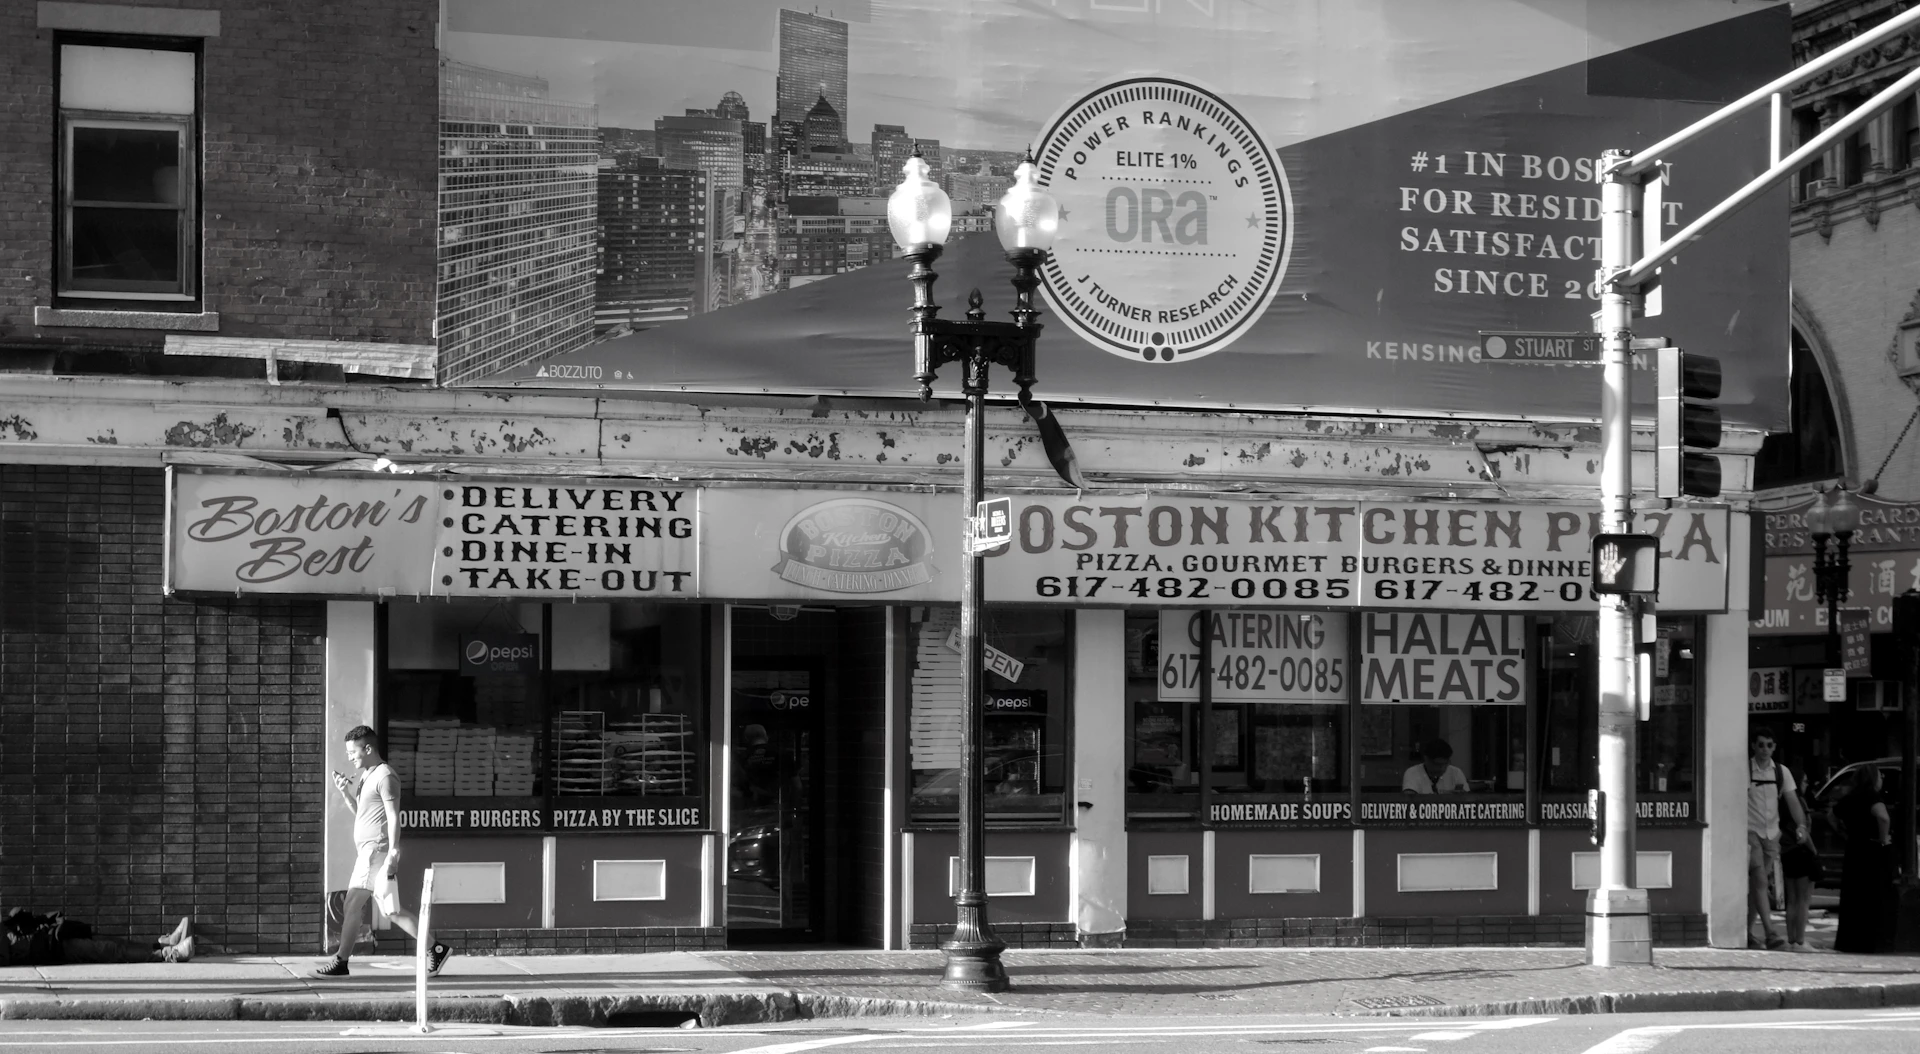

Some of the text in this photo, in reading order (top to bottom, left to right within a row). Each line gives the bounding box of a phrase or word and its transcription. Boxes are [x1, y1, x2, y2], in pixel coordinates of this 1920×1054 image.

[1065, 110, 1249, 187] POWER RANKINGS
[1116, 150, 1197, 170] ELITE 1%
[1411, 151, 1448, 173] #1
[1465, 151, 1506, 176] IN
[1400, 187, 1476, 214] FOR
[1434, 268, 1549, 297] SINCE
[1078, 274, 1239, 324] J TURNER RESEARCH
[1514, 338, 1595, 358] STUART ST
[549, 364, 603, 380] BOZZUTO
[461, 486, 685, 513] DELIVERY
[187, 489, 428, 543] Boston's
[461, 515, 693, 540] CATERING
[797, 505, 914, 542] BOSTON
[1857, 507, 1920, 526] GARD
[821, 531, 890, 547] Kitchen
[985, 503, 1229, 559] OSTON
[1249, 506, 1521, 549] KITCHEN
[1545, 510, 1721, 564] PZA
[235, 535, 374, 585] Best
[461, 541, 632, 565] DINE-IN
[803, 544, 910, 568] PIZZA
[1182, 554, 1328, 575] GOURMET
[1341, 556, 1473, 576] BURGERS
[1484, 558, 1503, 575] &
[1508, 558, 1591, 577] DINNE
[459, 567, 692, 593] TAKE-OUT
[825, 572, 876, 590] CATERING
[881, 561, 926, 588] DINNE
[1036, 575, 1602, 603] 617-482-0085 617-482-0
[1188, 613, 1325, 650] CATERING
[1366, 612, 1521, 656] HALAL
[489, 645, 533, 661] pepsi
[984, 648, 1019, 678] PEN
[1161, 653, 1344, 693] 617-482-0085
[1364, 658, 1521, 701] MEATS
[996, 697, 1031, 708] pepsi
[470, 809, 541, 828] BURGERS
[553, 807, 700, 828] PIZZA BY THE SLICE
[1210, 803, 1352, 822] HOMEMADE SOUPS
[1361, 802, 1525, 821] DELIVERY & CORPORATE CATERING
[1541, 802, 1689, 820] FOCASSIA ADE BREAD
